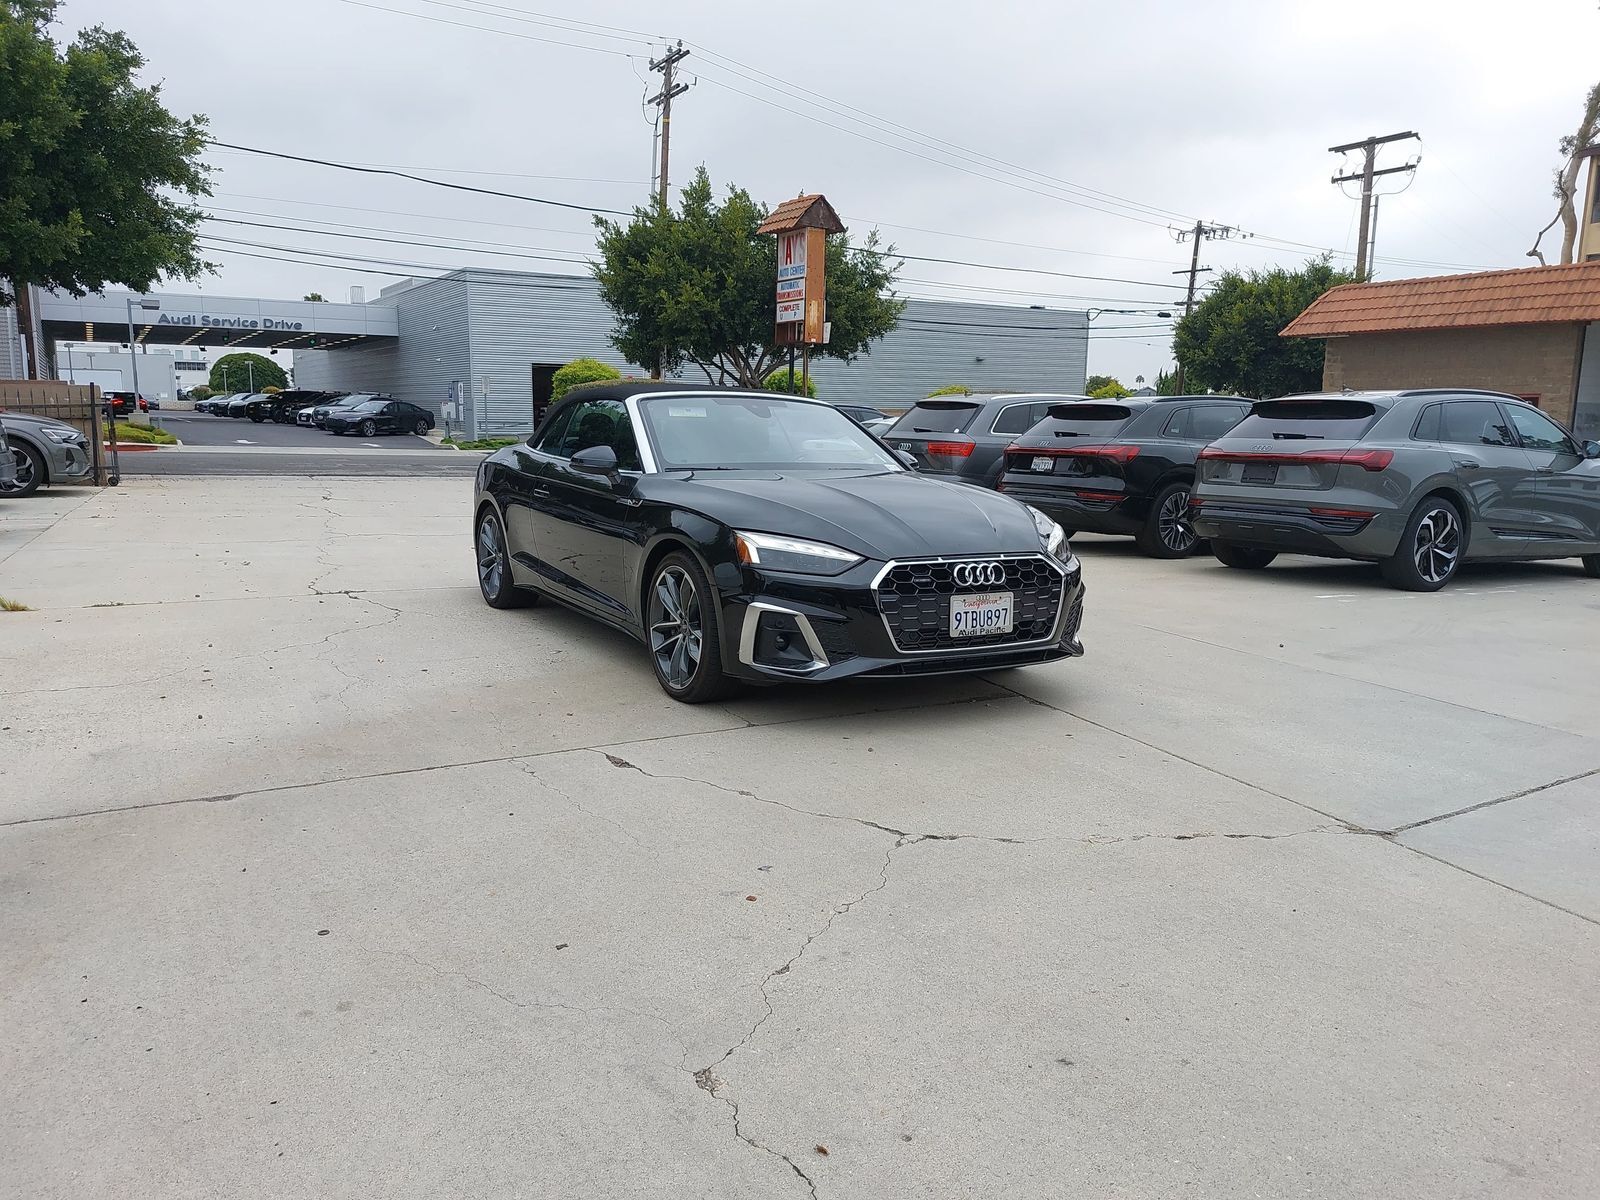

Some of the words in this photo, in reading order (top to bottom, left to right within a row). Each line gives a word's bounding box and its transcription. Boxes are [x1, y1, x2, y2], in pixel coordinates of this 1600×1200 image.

[780, 268, 789, 277] AUTO
[790, 265, 805, 275] CENTER
[781, 281, 799, 290] AUTOMATIC
[779, 304, 799, 312] COMPLETE
[158, 313, 196, 325] Audi
[201, 315, 259, 328] Service
[263, 318, 303, 330] Drive
[954, 608, 1008, 629] 9TBU897
